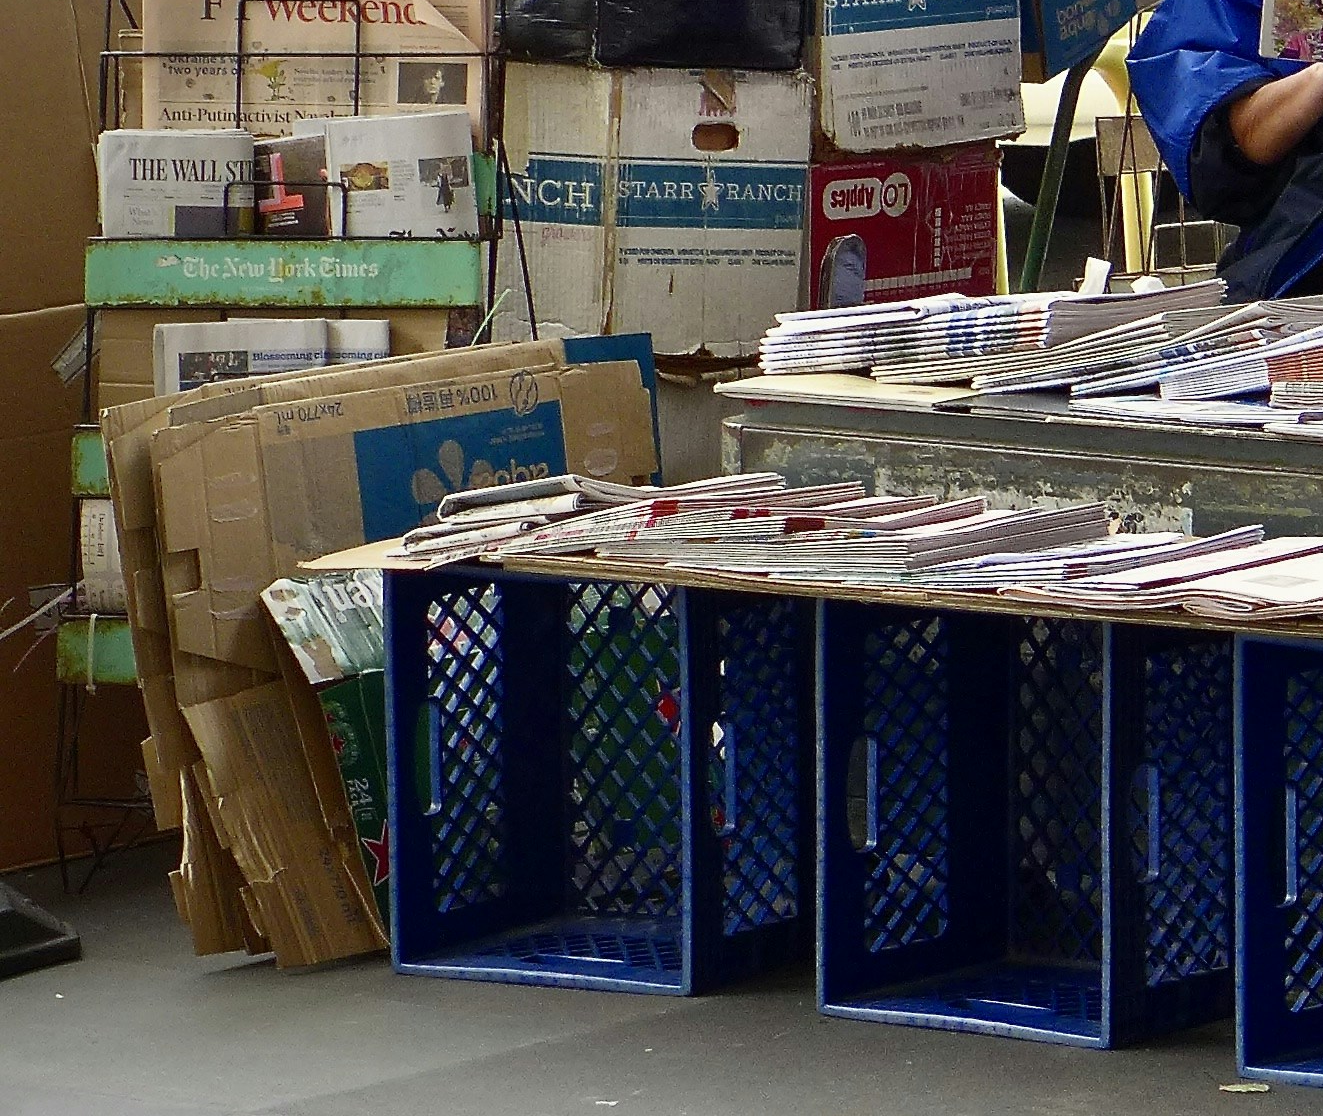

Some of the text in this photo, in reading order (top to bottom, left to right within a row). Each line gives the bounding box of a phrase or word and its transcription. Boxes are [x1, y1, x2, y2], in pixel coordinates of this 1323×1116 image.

[159, 107, 235, 123] Anti-Putin
[240, 109, 291, 124] activist
[128, 157, 168, 183] THE
[170, 157, 221, 183] WALL
[618, 180, 802, 202] STARR RANCH
[829, 184, 875, 213] Apples
[182, 256, 380, 283] The New York Times
[252, 350, 312, 362] Blossoming
